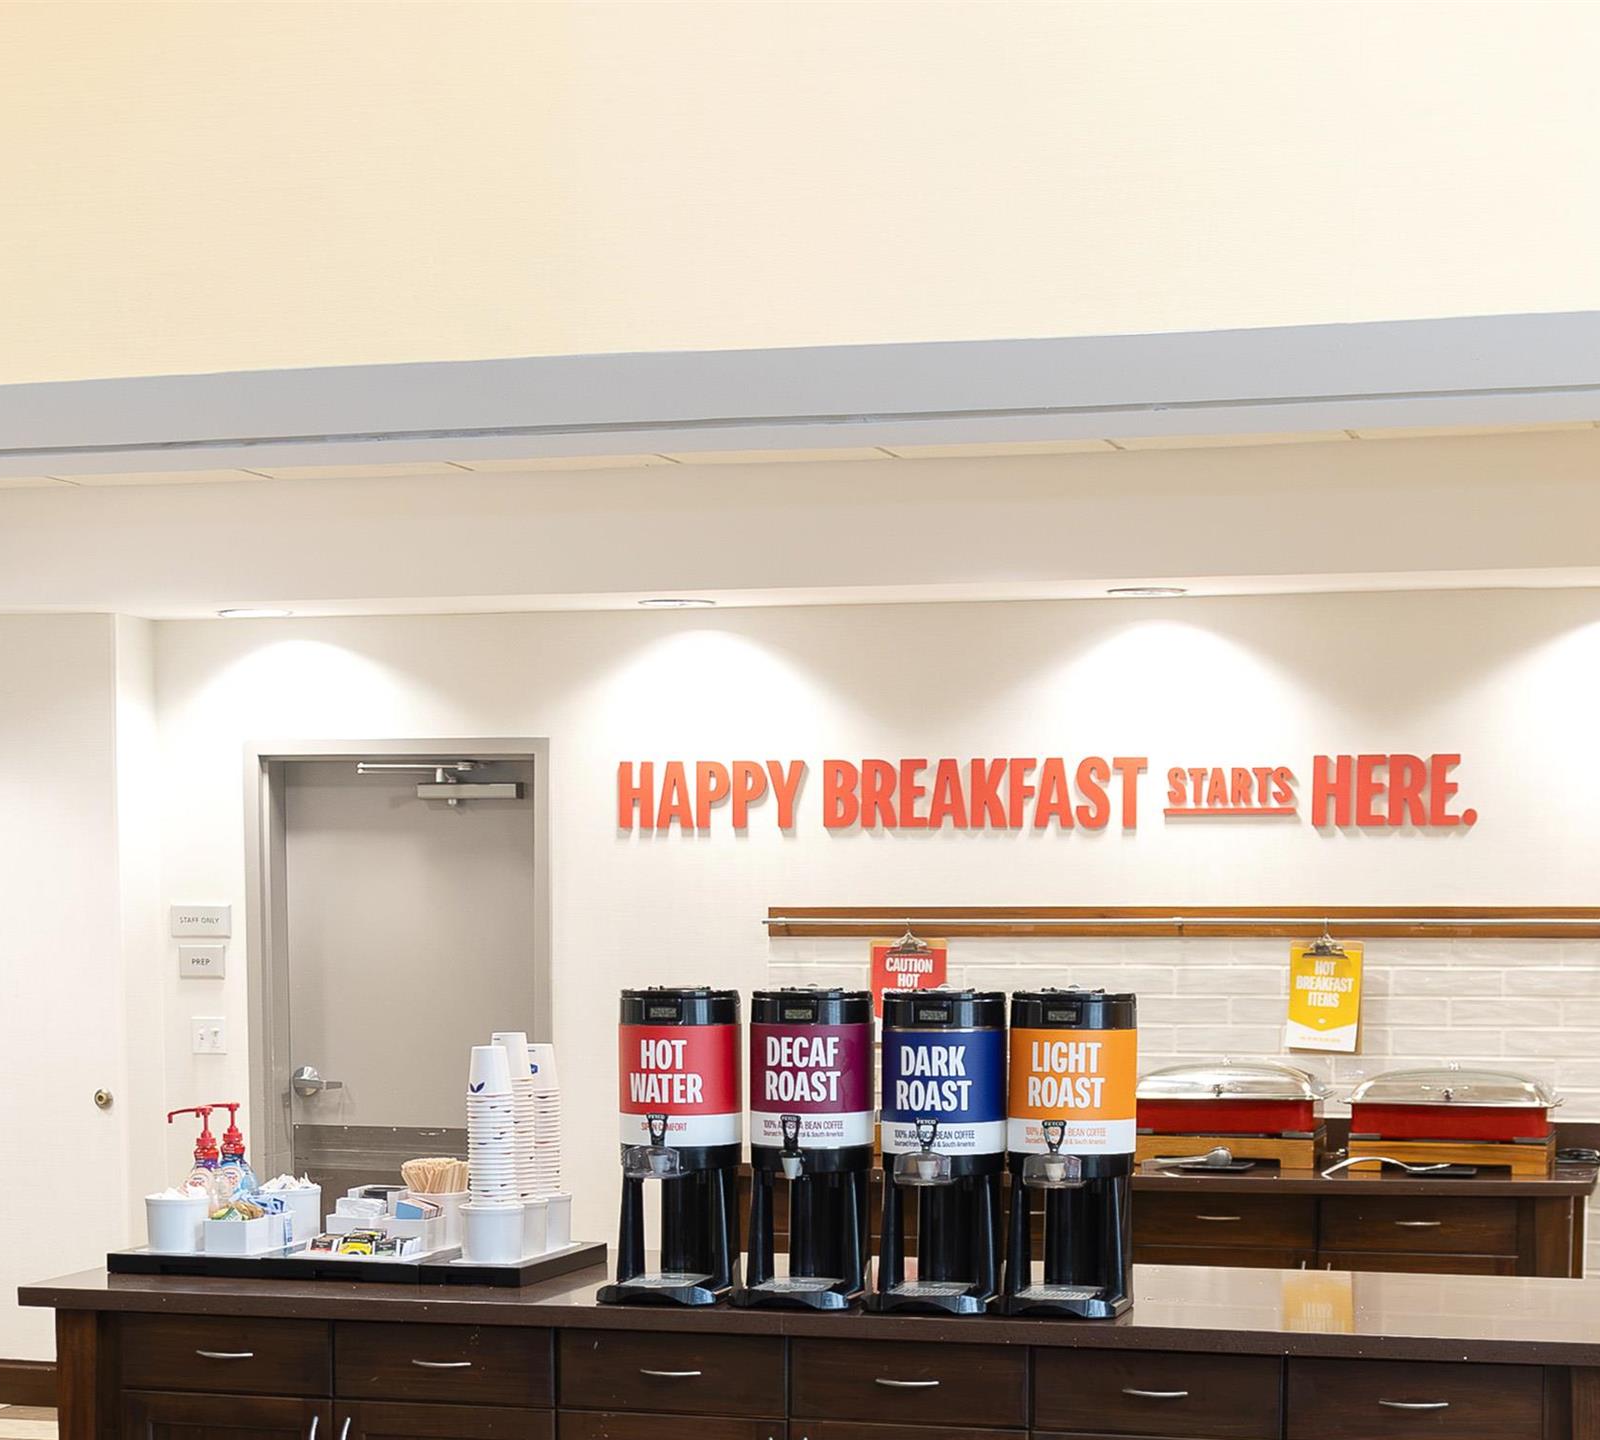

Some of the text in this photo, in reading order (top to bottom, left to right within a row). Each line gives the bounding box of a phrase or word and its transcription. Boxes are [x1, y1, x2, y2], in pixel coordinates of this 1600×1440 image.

[618, 753, 1478, 830] HAPPY BREAKFAST STARTS HERE.
[179, 916, 220, 924] STAFF ONLY
[191, 958, 211, 966] PREP
[885, 957, 934, 973] CAUTION
[1314, 960, 1336, 976] HOT
[897, 973, 920, 988] HOT
[1296, 975, 1354, 993] BREAKFAST
[1308, 991, 1340, 1008] ITEMS
[640, 1039, 687, 1070] HOT
[766, 1036, 840, 1068] DECAF
[900, 1045, 967, 1076] DARK
[1032, 1041, 1103, 1073] LIGHT
[630, 1072, 704, 1104] WATER
[765, 1071, 841, 1102] ROAST
[896, 1080, 973, 1112] ROAST
[1027, 1076, 1106, 1108] ROAST
[805, 1121, 822, 1130] BEAN
[823, 1121, 844, 1130] COFFEE
[954, 1130, 975, 1139] COFFEE
